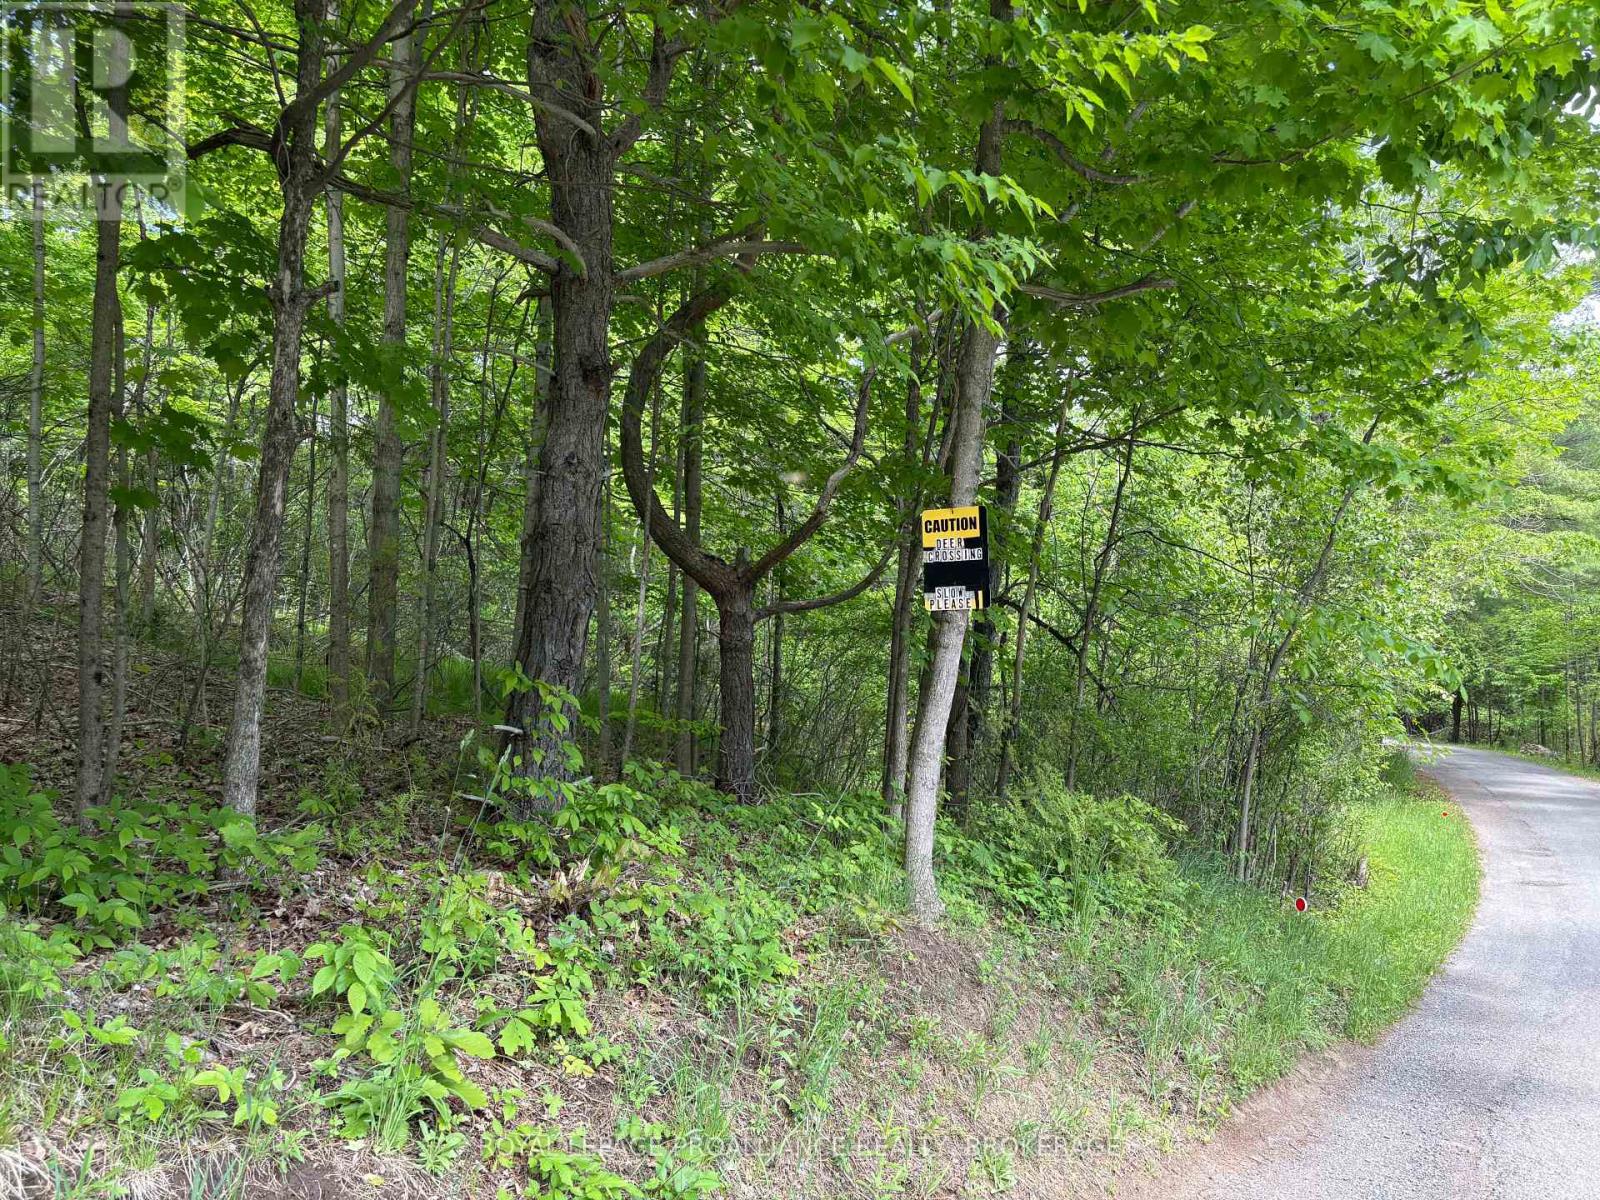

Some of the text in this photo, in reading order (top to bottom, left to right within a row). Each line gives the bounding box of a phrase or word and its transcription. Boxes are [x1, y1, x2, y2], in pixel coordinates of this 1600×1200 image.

[924, 516, 977, 533] CAUTION
[936, 538, 963, 549] DEER
[928, 549, 983, 562] CROSSING
[936, 588, 963, 599] SLOW
[929, 598, 971, 609] PLEASE
